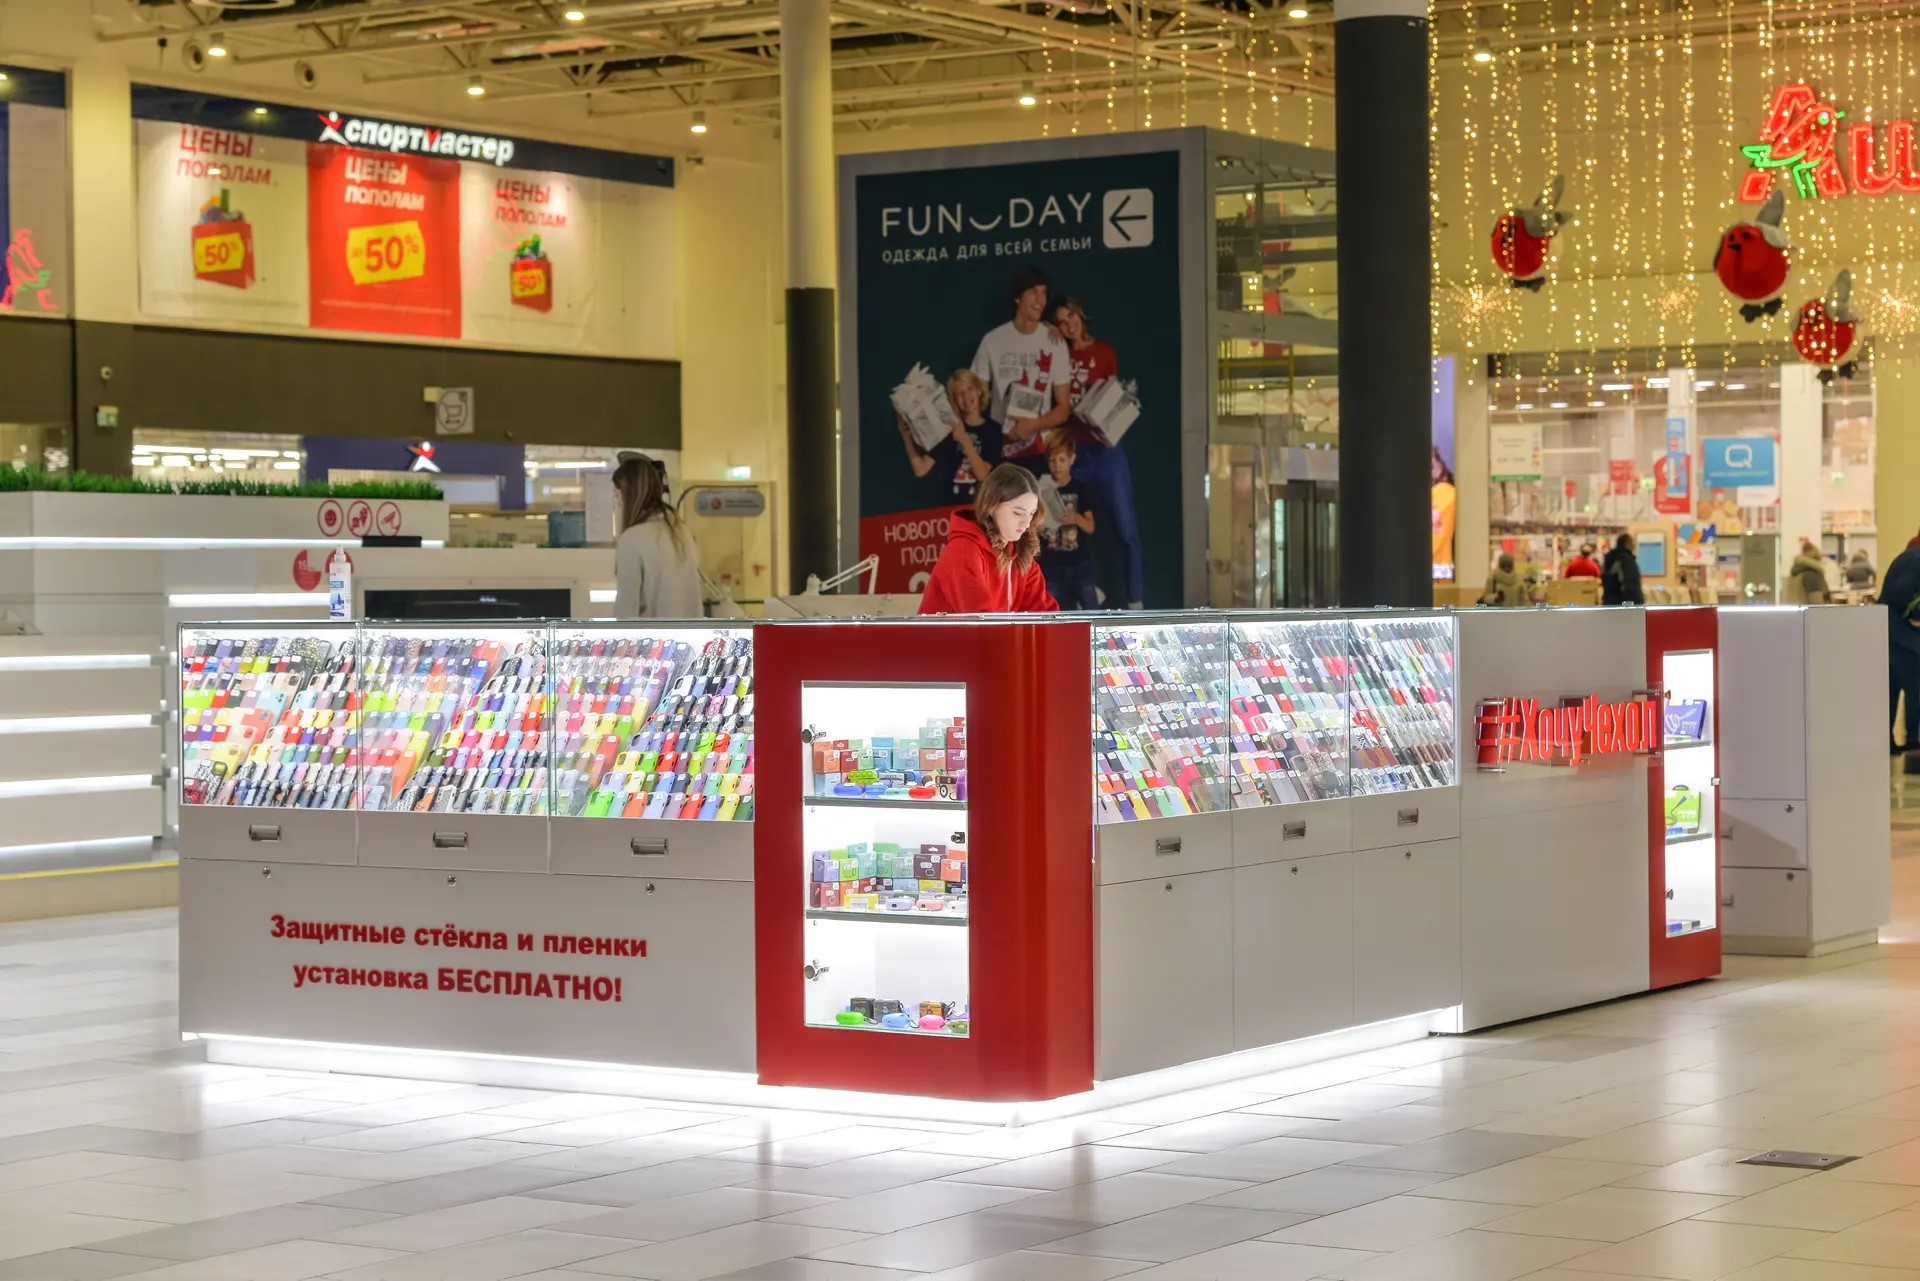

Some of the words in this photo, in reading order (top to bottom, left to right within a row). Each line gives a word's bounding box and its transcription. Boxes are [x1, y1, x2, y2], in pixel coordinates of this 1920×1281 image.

[179, 123, 253, 158] ЦЕНЫ
[177, 158, 272, 185] ПОПОЛАМ
[344, 156, 409, 186] ЦЕНЫ
[344, 185, 425, 211] ПОПОЛАМ
[495, 178, 550, 205] ЦЕНЫ
[495, 205, 567, 228] ПОПОЛАМ
[881, 202, 963, 238] FUN
[1008, 191, 1093, 229] DAY
[881, 247, 949, 265] ОДЕЖДА
[956, 243, 988, 261] ДЛЯ
[994, 236, 1032, 257] ВСЕЙ
[1039, 235, 1092, 253] СЕМЬИ
[884, 517, 950, 544] НОВОГО
[1474, 693, 1658, 767] #ХочуЧехол
[270, 914, 406, 945] Защитные
[414, 922, 507, 951] стёкла
[517, 932, 534, 952] и
[543, 934, 648, 958] пленки
[293, 964, 430, 991] установка
[437, 966, 623, 1003] БЕСПЛАТНО!
